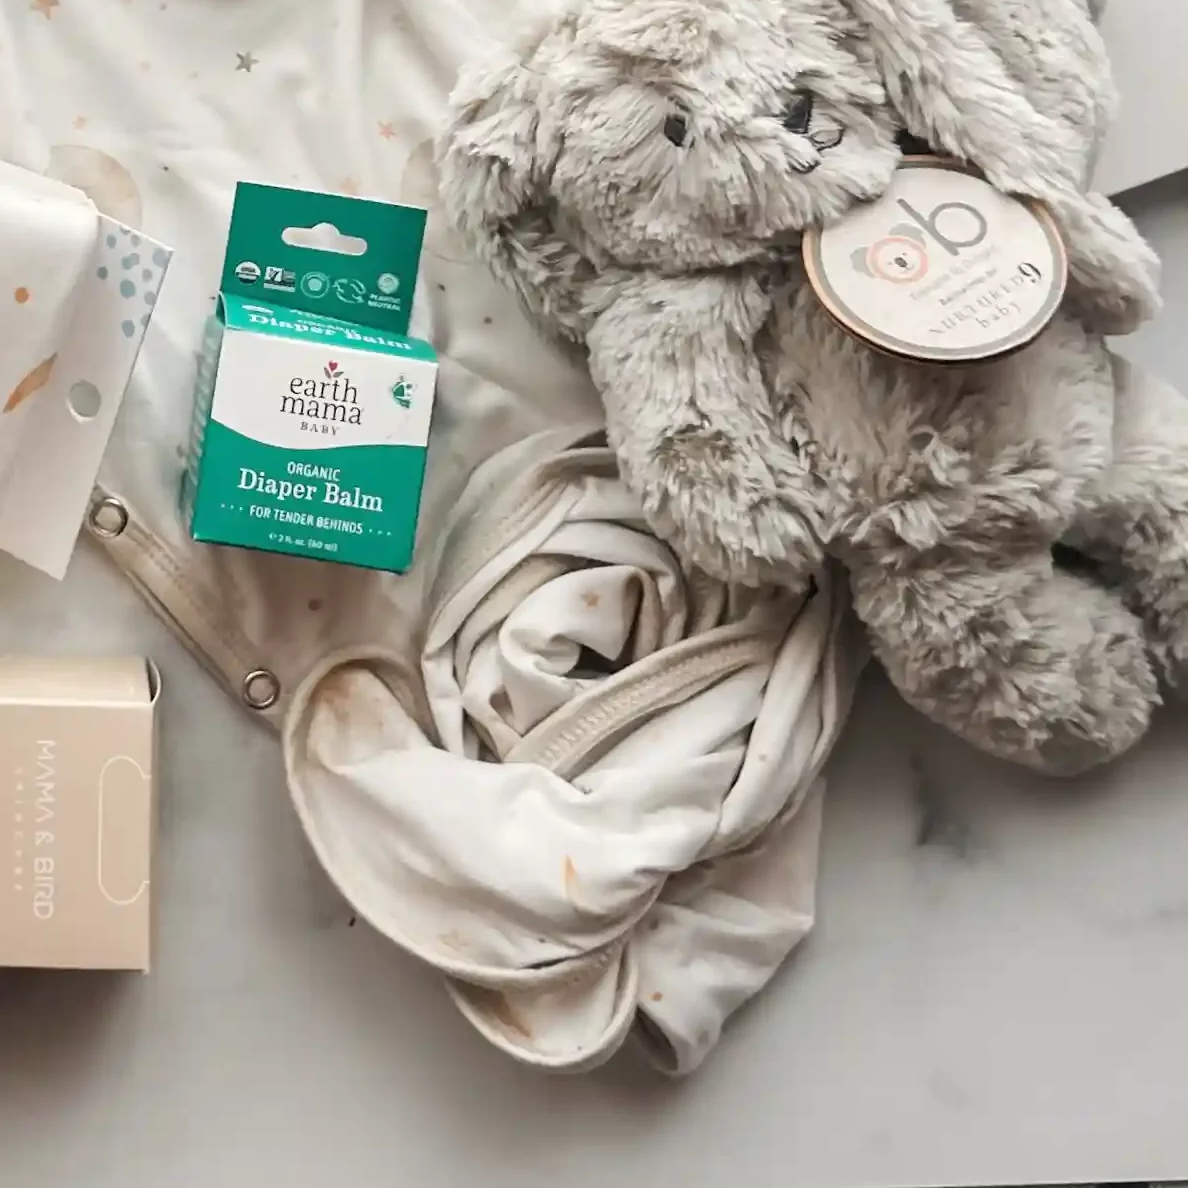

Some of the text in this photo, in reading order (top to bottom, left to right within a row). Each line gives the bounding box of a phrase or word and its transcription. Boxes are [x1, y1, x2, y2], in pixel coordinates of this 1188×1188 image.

[290, 377, 358, 405] earth
[280, 395, 362, 425] mama
[300, 421, 340, 436] BABY
[287, 461, 340, 482] ORGANIC
[238, 468, 383, 512] Diaper Balm
[249, 505, 363, 535] FOR TENDER BEHINDS
[33, 740, 57, 920] MAMA & BIRD
